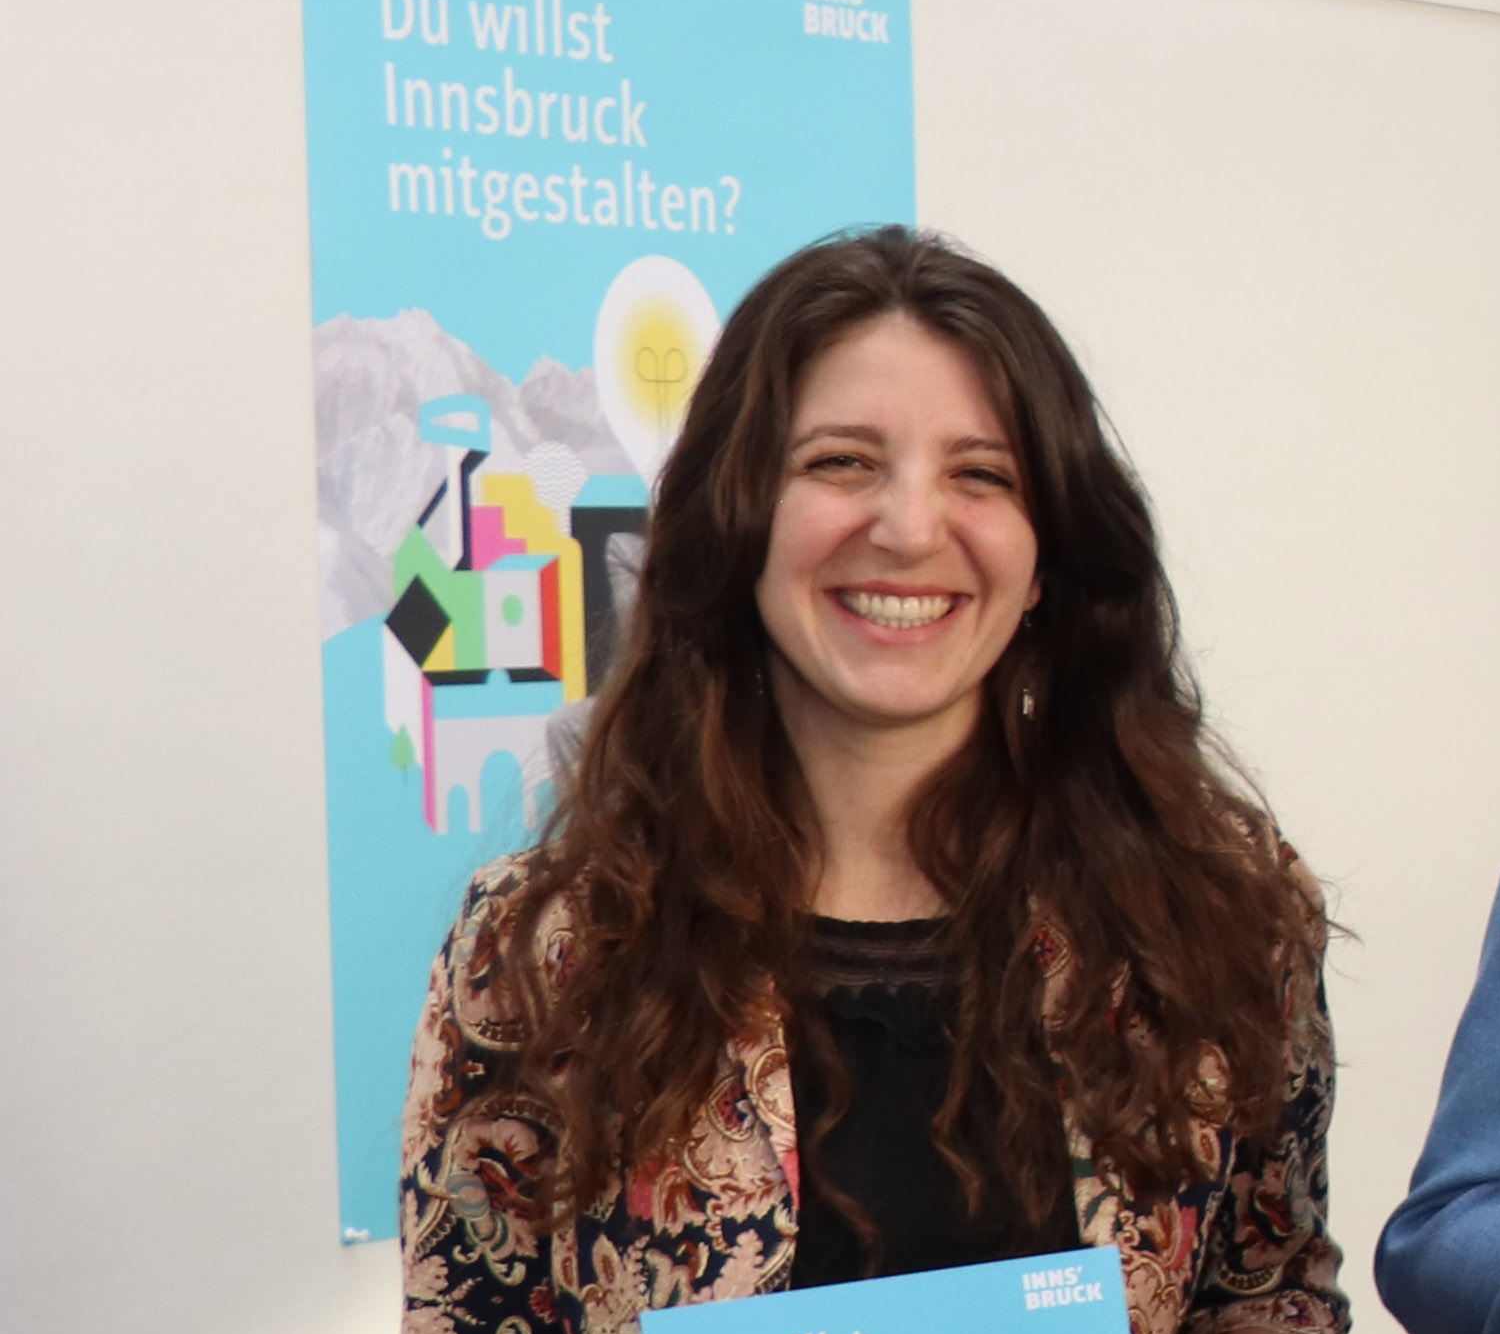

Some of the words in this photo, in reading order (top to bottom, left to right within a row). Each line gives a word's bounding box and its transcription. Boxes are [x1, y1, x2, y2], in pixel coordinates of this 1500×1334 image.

[803, 2, 889, 44] BRUCK
[385, 62, 647, 148] Innsbruck
[388, 148, 741, 241] mitgestalten?
[1023, 1266, 1082, 1291] INNS'
[1026, 1282, 1104, 1310] BRUCK
